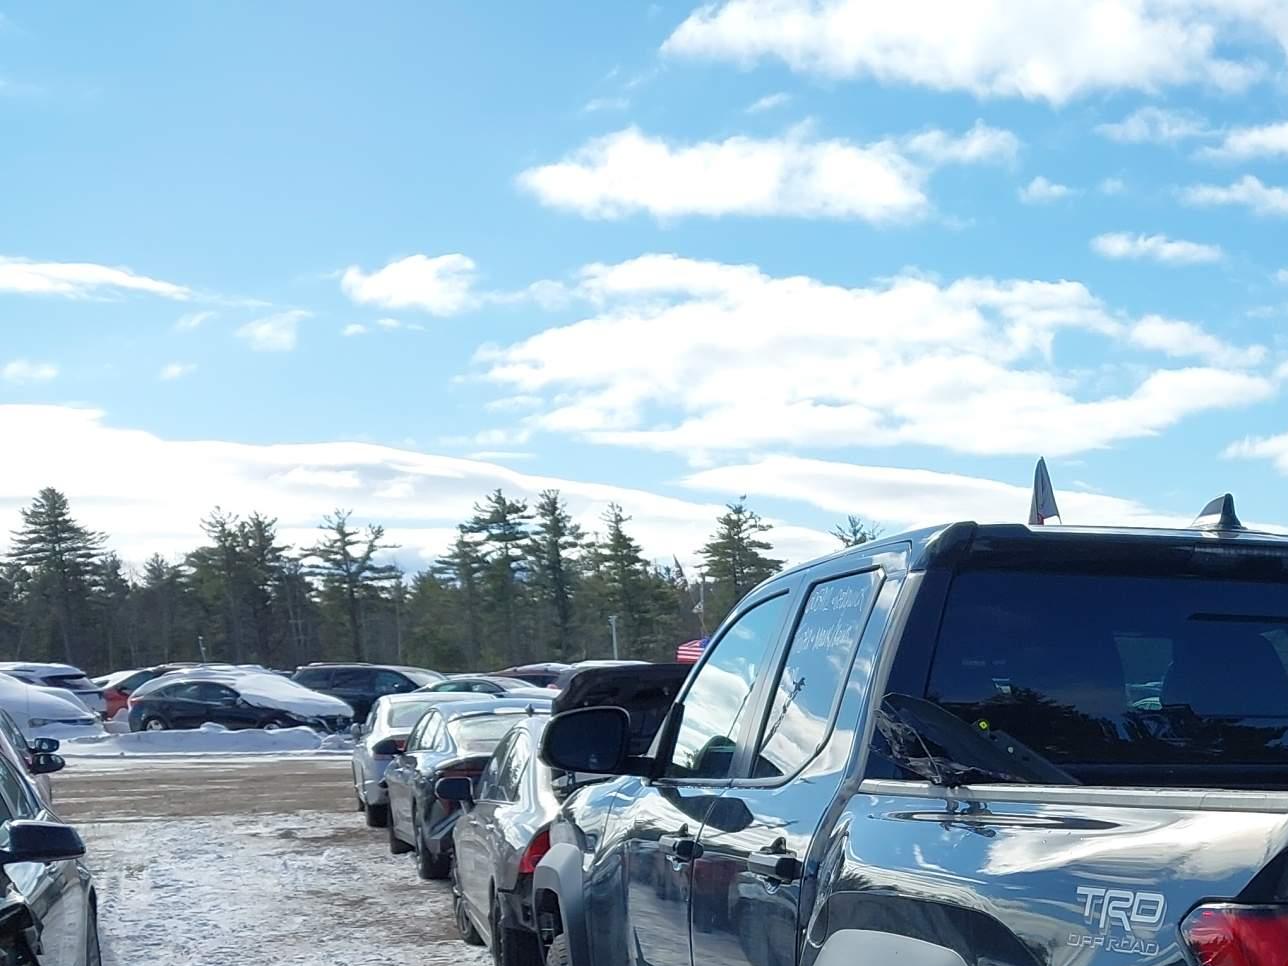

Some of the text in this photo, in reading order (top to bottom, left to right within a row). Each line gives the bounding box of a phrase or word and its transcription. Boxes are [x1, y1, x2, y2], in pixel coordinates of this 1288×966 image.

[1076, 886, 1165, 932] TRD
[1066, 934, 1160, 956] OFF ROAD
